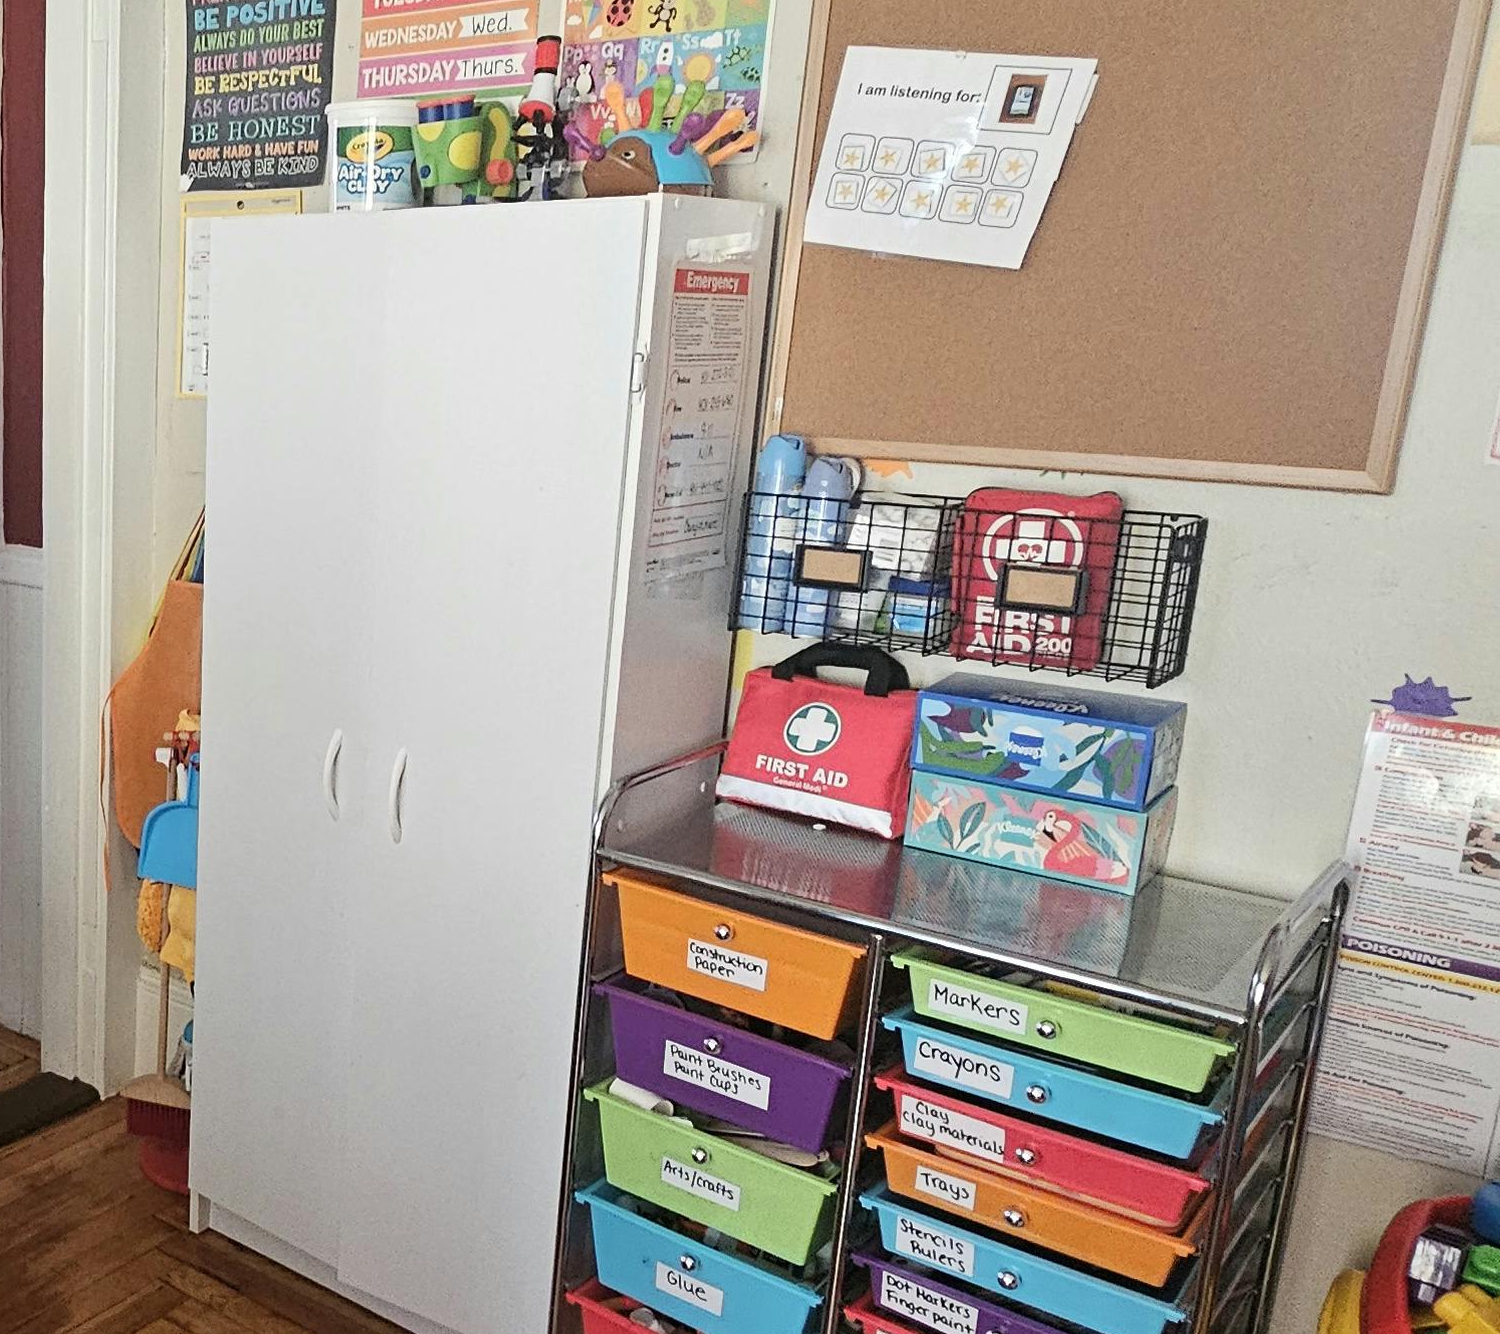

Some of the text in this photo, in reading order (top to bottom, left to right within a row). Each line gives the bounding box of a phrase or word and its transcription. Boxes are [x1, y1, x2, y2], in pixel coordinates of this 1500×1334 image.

[194, 7, 220, 31] BE
[365, 13, 512, 48] WEDNESDAY Wed.
[194, 20, 324, 52] ALWAYS DO YOUR BEST
[194, 43, 323, 73] BELIEVE IN YOURSELF
[194, 64, 321, 95] BE RESPECTFUL
[363, 59, 518, 89] THURSDAY Thurs.
[192, 88, 321, 118] ASK QUESTIONS
[858, 83, 982, 103] I am listening for:
[191, 116, 321, 143] BE HONEST
[188, 140, 318, 160] WORK HARD & HAVE FUN
[187, 155, 318, 179] ALWAYS BE KIND
[686, 272, 740, 292] Emergency
[755, 754, 848, 788] FIRST AID
[689, 941, 763, 975] Construction
[1347, 938, 1451, 968] POISONING
[934, 985, 1021, 1026] Markers
[670, 1045, 762, 1091] Paint Brushes
[918, 1041, 1001, 1082] Crayons
[916, 1100, 950, 1124] Clay
[902, 1111, 1005, 1156] clay materials
[920, 1172, 970, 1200] Trays
[900, 1218, 965, 1255] Stencils
[910, 1241, 966, 1273] Rulers
[667, 1271, 707, 1302] Glue
[887, 1274, 971, 1319] Dot Markers
[887, 1290, 975, 1334] Finger paint
